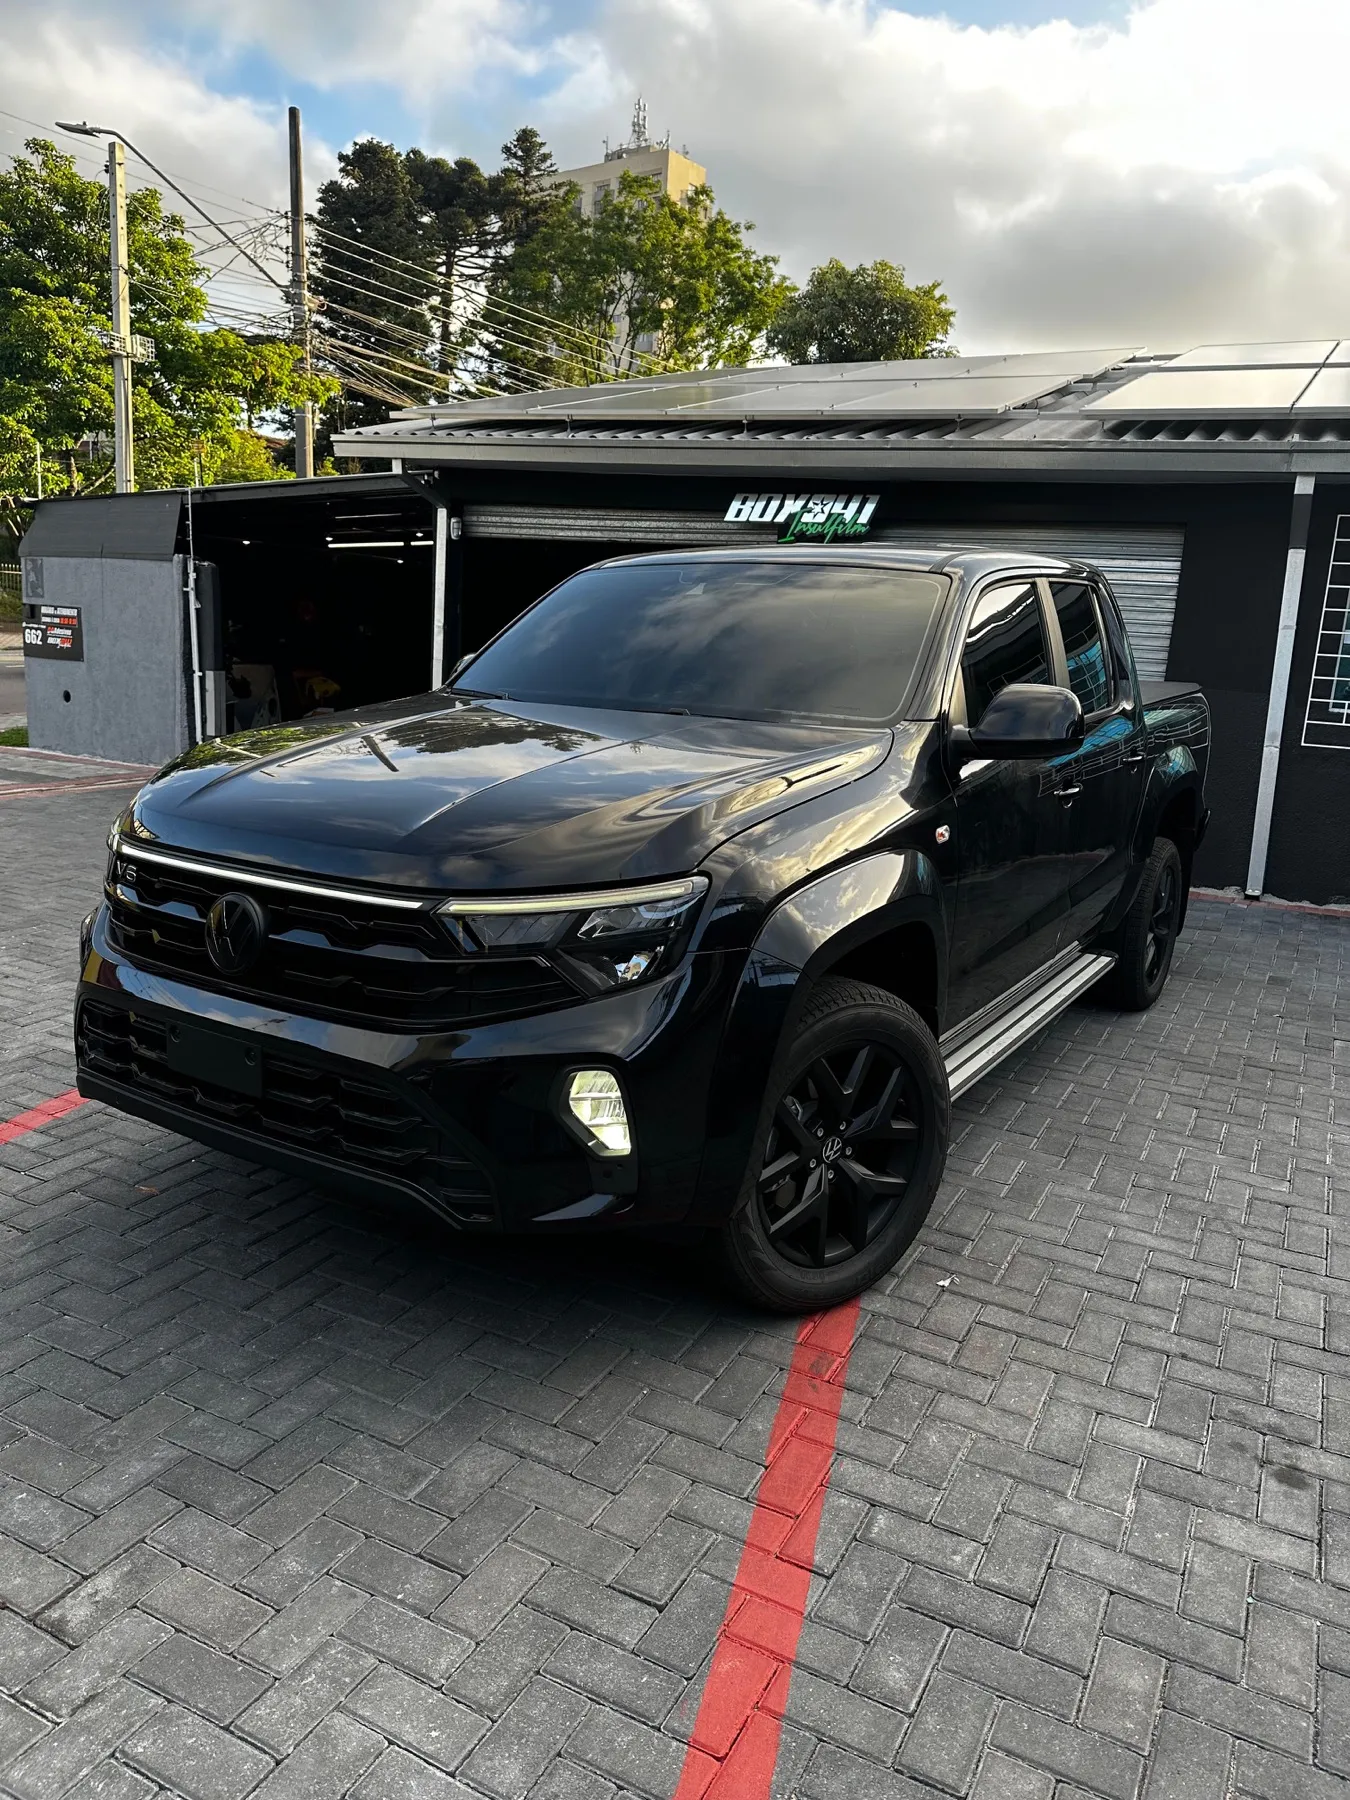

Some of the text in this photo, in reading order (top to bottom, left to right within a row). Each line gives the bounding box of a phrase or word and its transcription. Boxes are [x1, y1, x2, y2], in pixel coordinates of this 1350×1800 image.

[778, 508, 870, 544] Insulfilm
[24, 628, 43, 645] 662
[116, 860, 137, 882] V6
